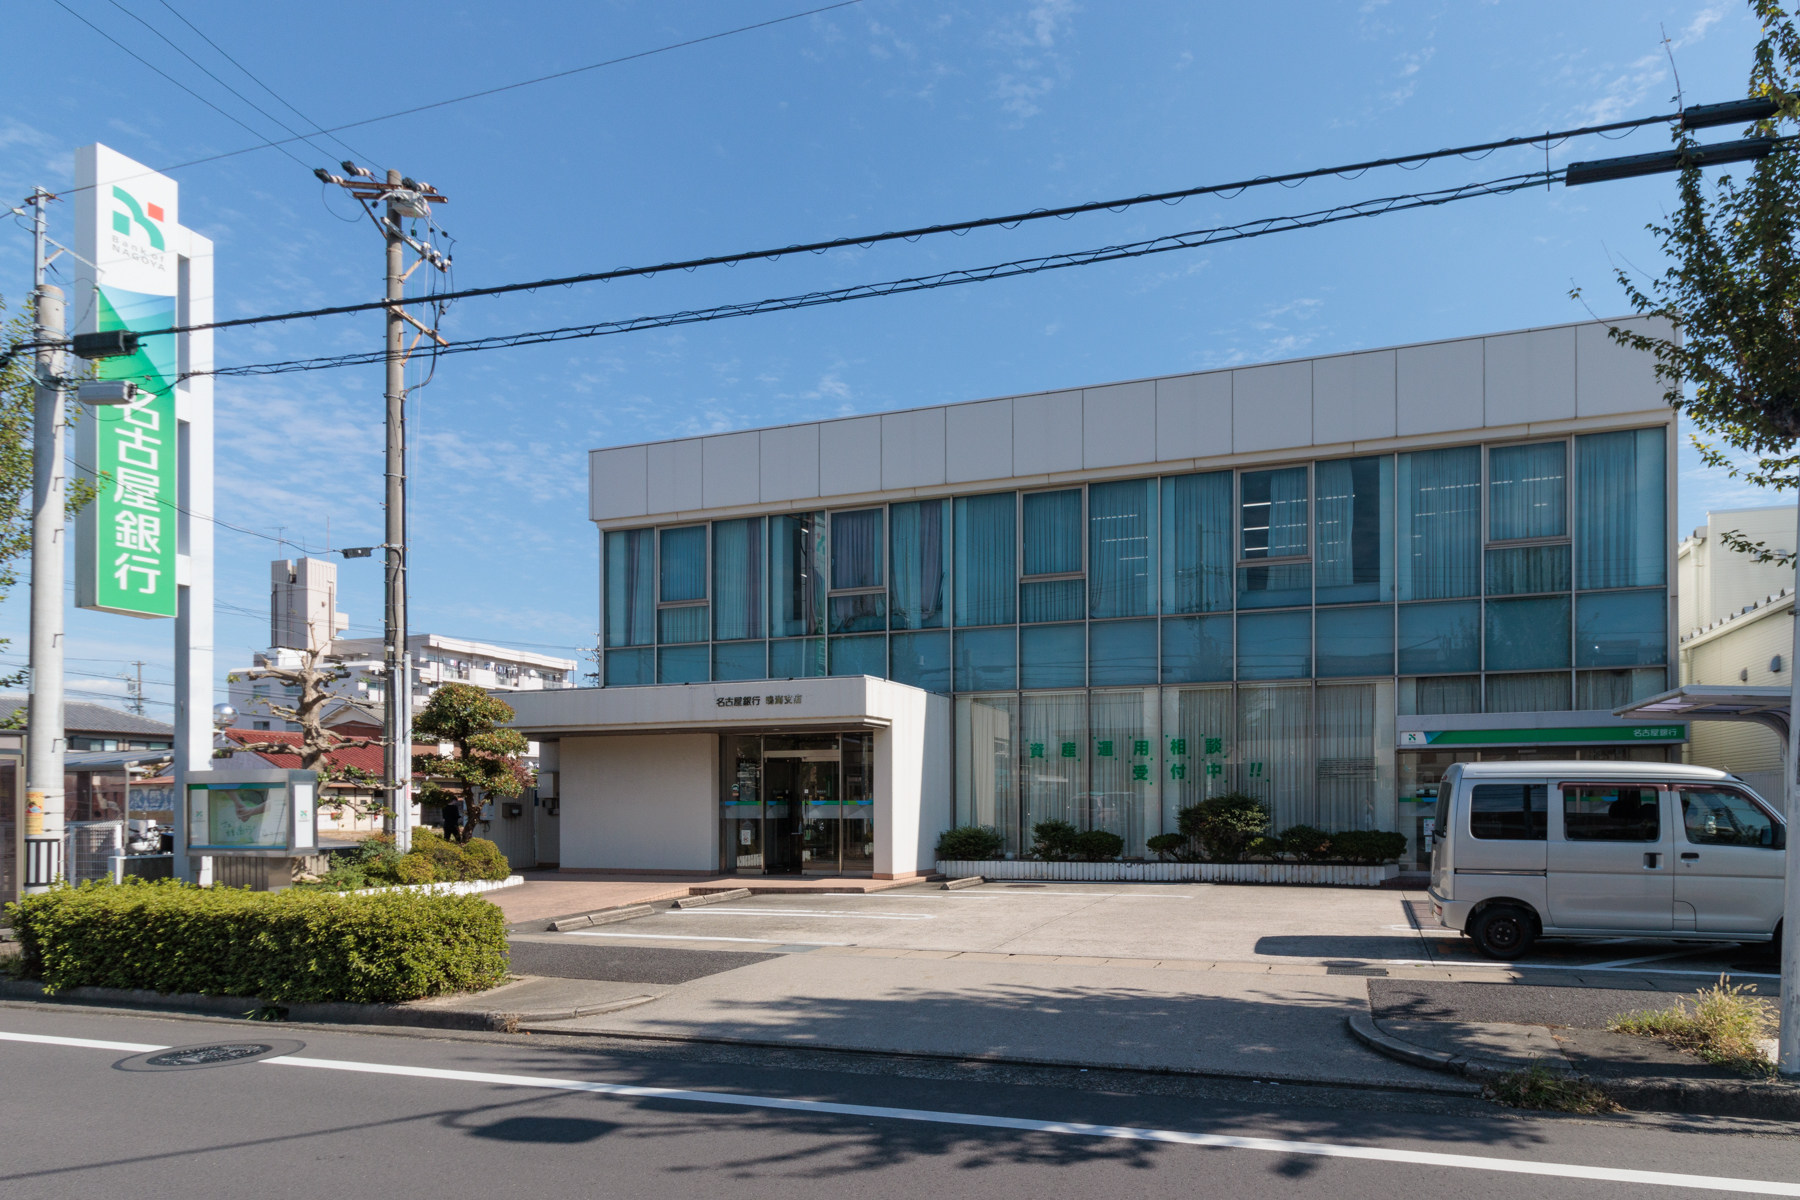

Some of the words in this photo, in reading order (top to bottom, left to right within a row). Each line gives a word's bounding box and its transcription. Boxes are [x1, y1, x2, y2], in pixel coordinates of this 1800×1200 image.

[112, 235, 147, 256] Bank
[151, 253, 165, 263] of
[112, 243, 165, 272] NAGOYA
[113, 385, 162, 595] 名古屋銀行
[716, 696, 760, 707] 名古屋銀行
[765, 694, 803, 705] 鳴海支店
[1633, 728, 1677, 737] 名古屋銀行
[1029, 737, 1222, 759] 資産運用相談
